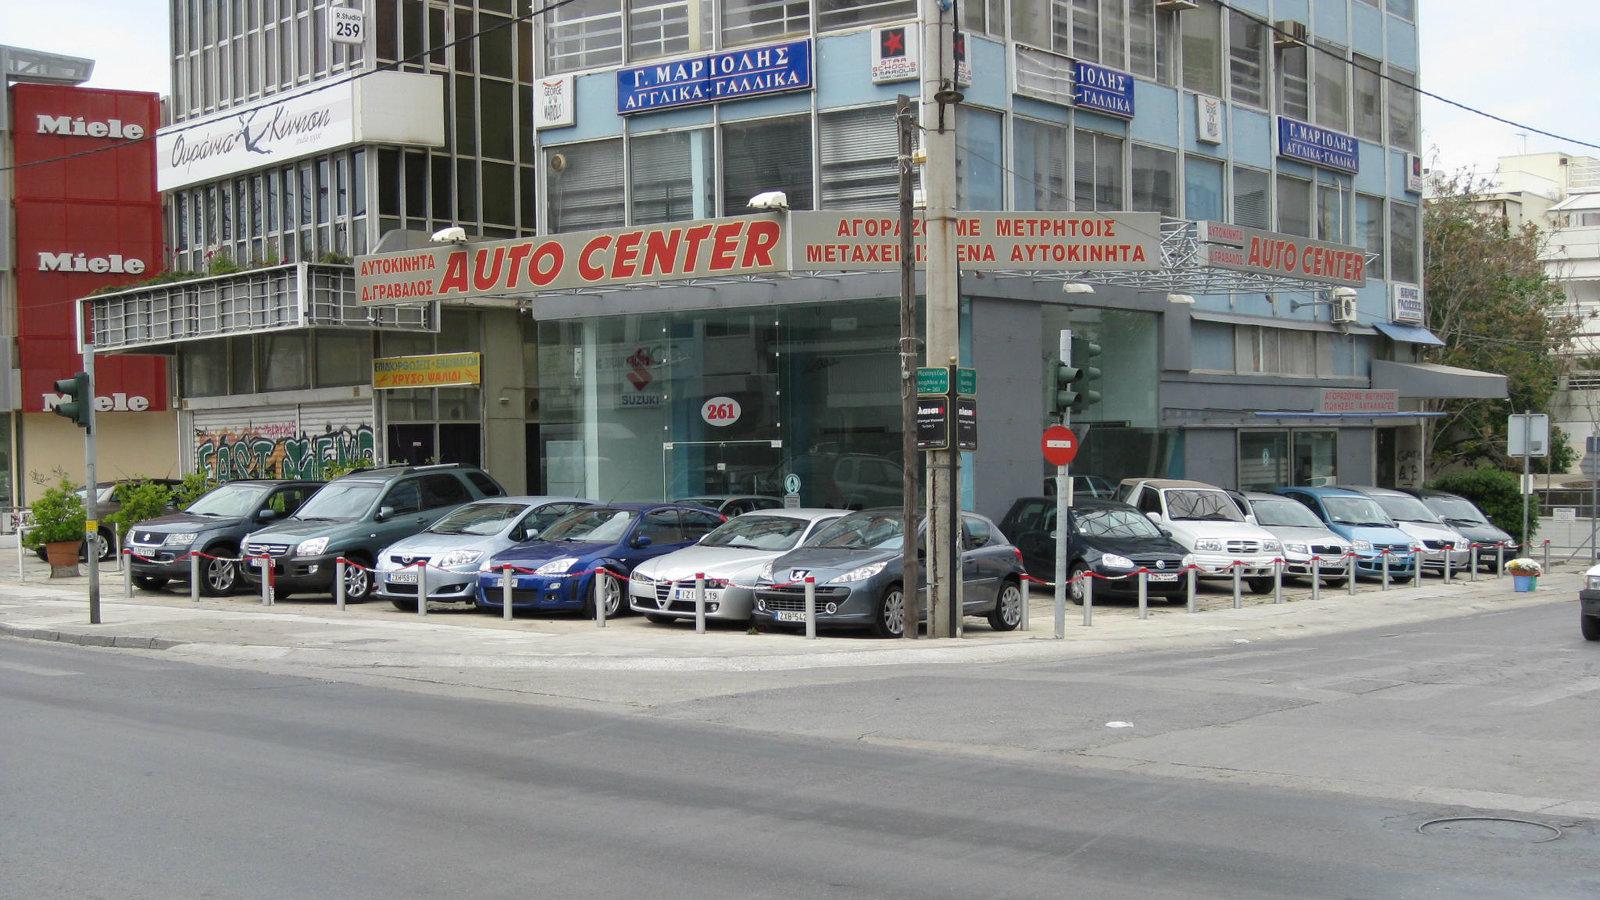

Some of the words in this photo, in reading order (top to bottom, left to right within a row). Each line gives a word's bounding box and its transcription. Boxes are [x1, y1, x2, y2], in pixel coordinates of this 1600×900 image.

[337, 22, 360, 37] 259
[634, 70, 648, 87] Γ.
[656, 47, 789, 83] ΜΑΡΙΟΛΗΣ
[37, 115, 144, 140] Miele
[1300, 127, 1352, 151] ΜΑΡΙΟΛΗΣ
[837, 219, 981, 237] ΑΓΟΡΑΖΜΕ
[996, 219, 1116, 237] ΜΕΤΡΗΤΟΙΣ
[38, 252, 145, 275] Miele
[438, 241, 565, 294] AUTO
[578, 220, 781, 282] CENTER
[1010, 244, 1147, 262] ΑΥΤΟΚΙΝΗΤΑ
[1248, 236, 1298, 272] AUTO
[1302, 246, 1365, 282] CENTER
[361, 254, 435, 276] ΑΥΤΟΚΙΝΗΤΑ
[361, 280, 433, 302] Δ.ΓΡΑΒΑΛΟΣ
[622, 395, 659, 405] SUZUKI
[707, 404, 736, 420] 261
